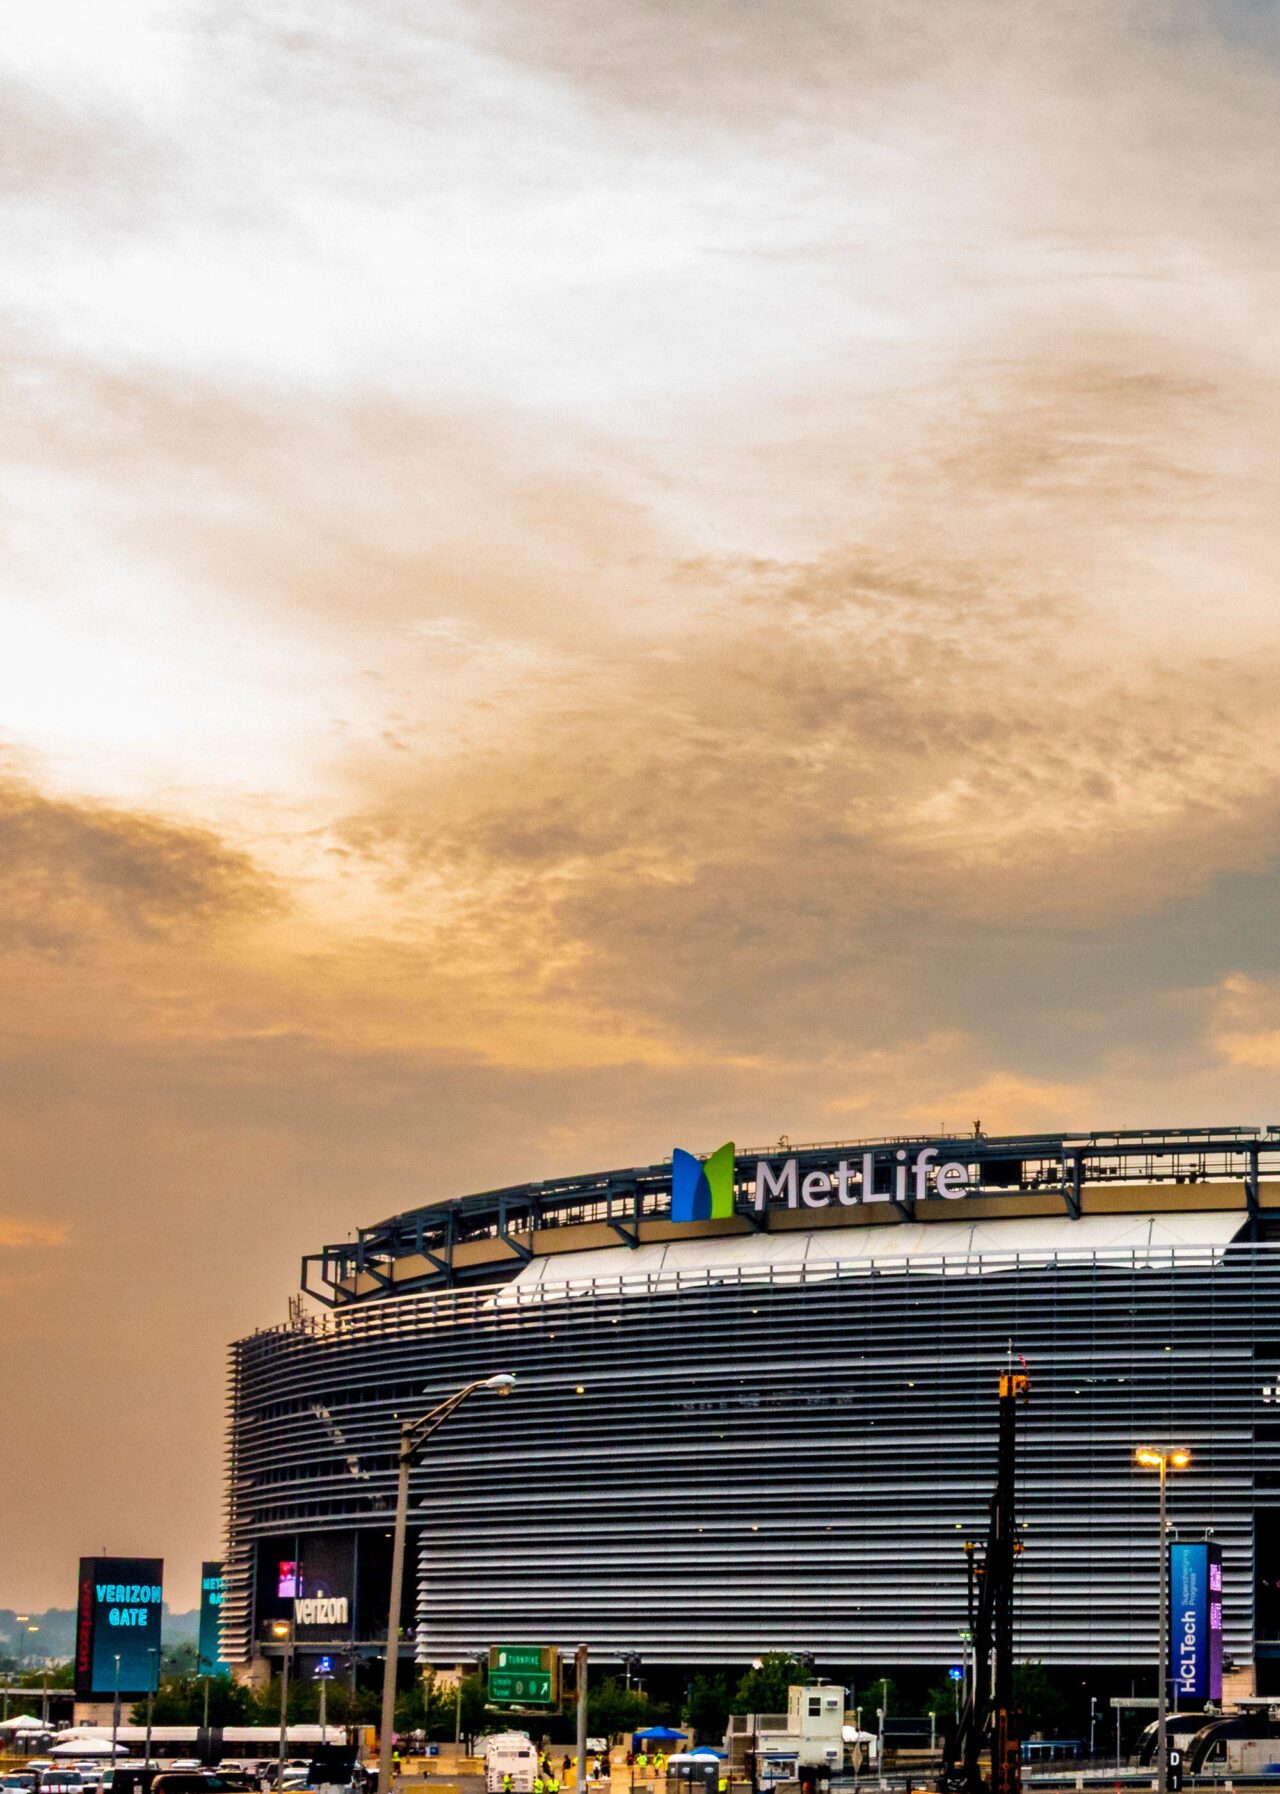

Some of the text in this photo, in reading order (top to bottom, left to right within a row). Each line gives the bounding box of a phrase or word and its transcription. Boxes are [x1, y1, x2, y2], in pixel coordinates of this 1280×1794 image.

[754, 1147, 970, 1212] MetLife
[96, 1585, 162, 1603] VERIZON
[295, 1589, 348, 1624] verizon
[108, 1607, 148, 1627] GATE
[509, 1656, 539, 1665] TURNPIKE
[1181, 1610, 1196, 1692] HCLTech
[1170, 1751, 1180, 1766] D
[1172, 1775, 1178, 1790] 1
